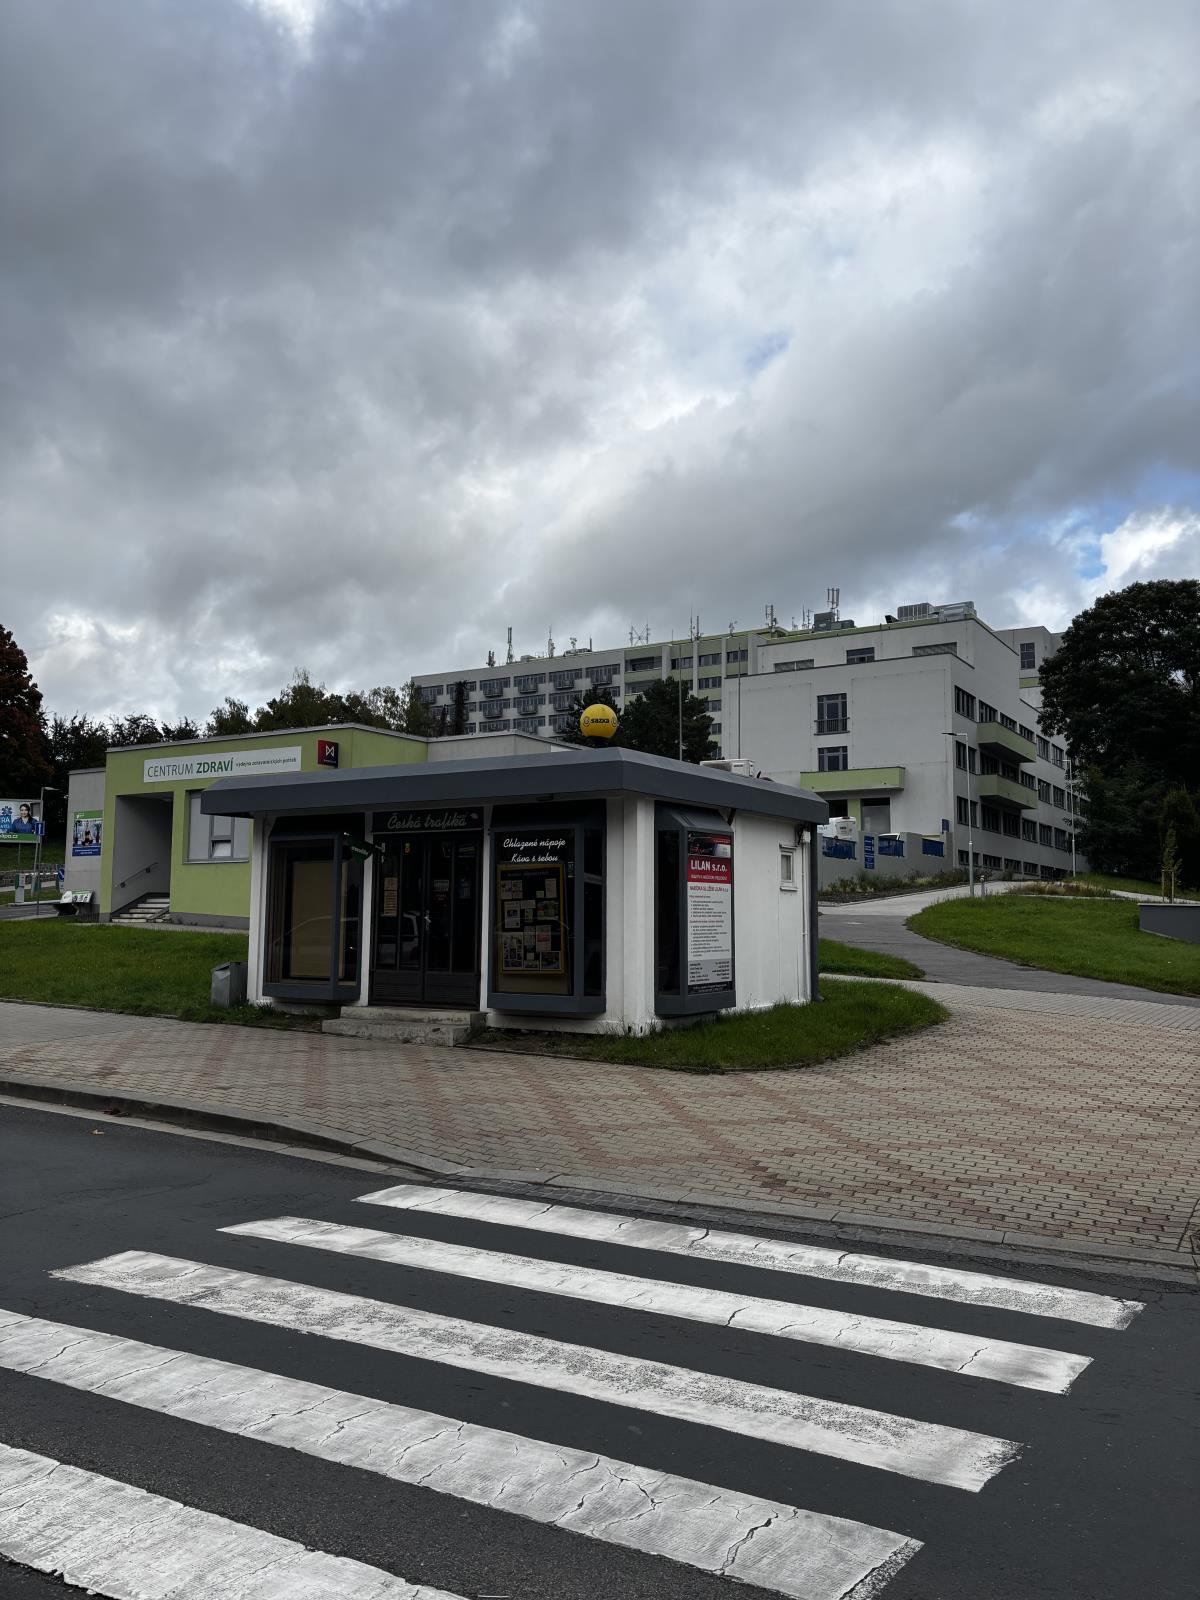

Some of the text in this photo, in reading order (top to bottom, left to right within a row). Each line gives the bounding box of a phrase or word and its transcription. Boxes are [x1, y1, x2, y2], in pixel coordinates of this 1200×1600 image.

[147, 763, 193, 778] CENTRUM
[196, 757, 234, 774] ZDRAVÍ
[387, 810, 467, 829] Česká trafika
[503, 837, 566, 851] Chlazené nápoje
[511, 853, 530, 863] Káva
[537, 852, 558, 862] sebou
[690, 859, 728, 872] LILAN s.r.o.
